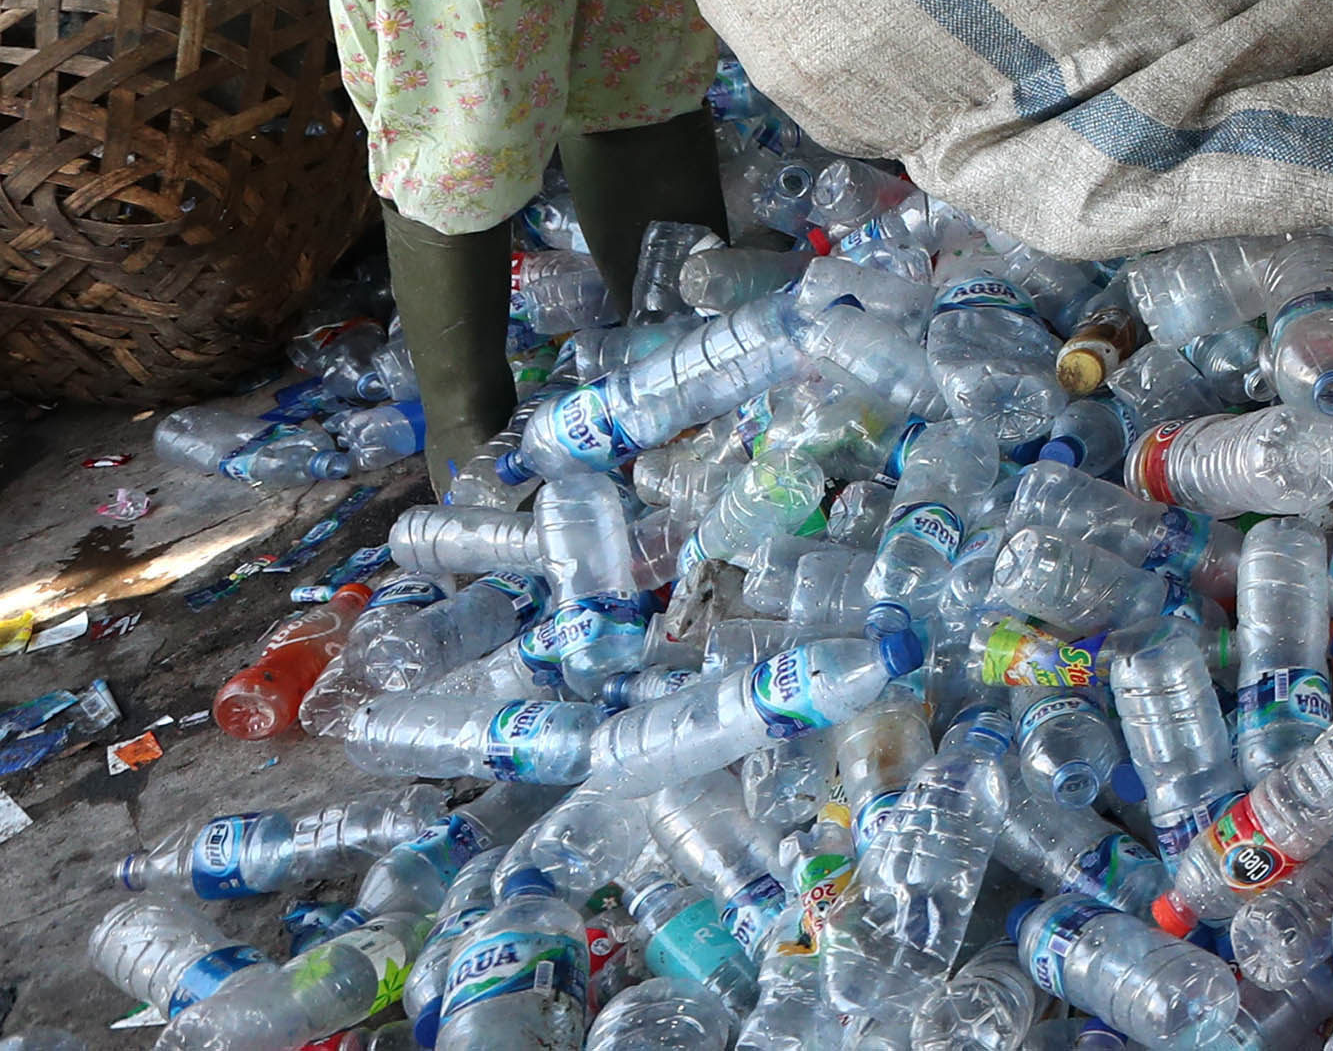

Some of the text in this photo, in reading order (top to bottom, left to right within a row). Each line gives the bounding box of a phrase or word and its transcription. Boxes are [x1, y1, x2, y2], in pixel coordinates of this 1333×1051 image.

[952, 280, 1018, 301] AQUA
[560, 395, 602, 452] AQUA
[913, 515, 959, 553] AQUA
[780, 650, 802, 701] AQUA
[1237, 848, 1270, 882] Cleo
